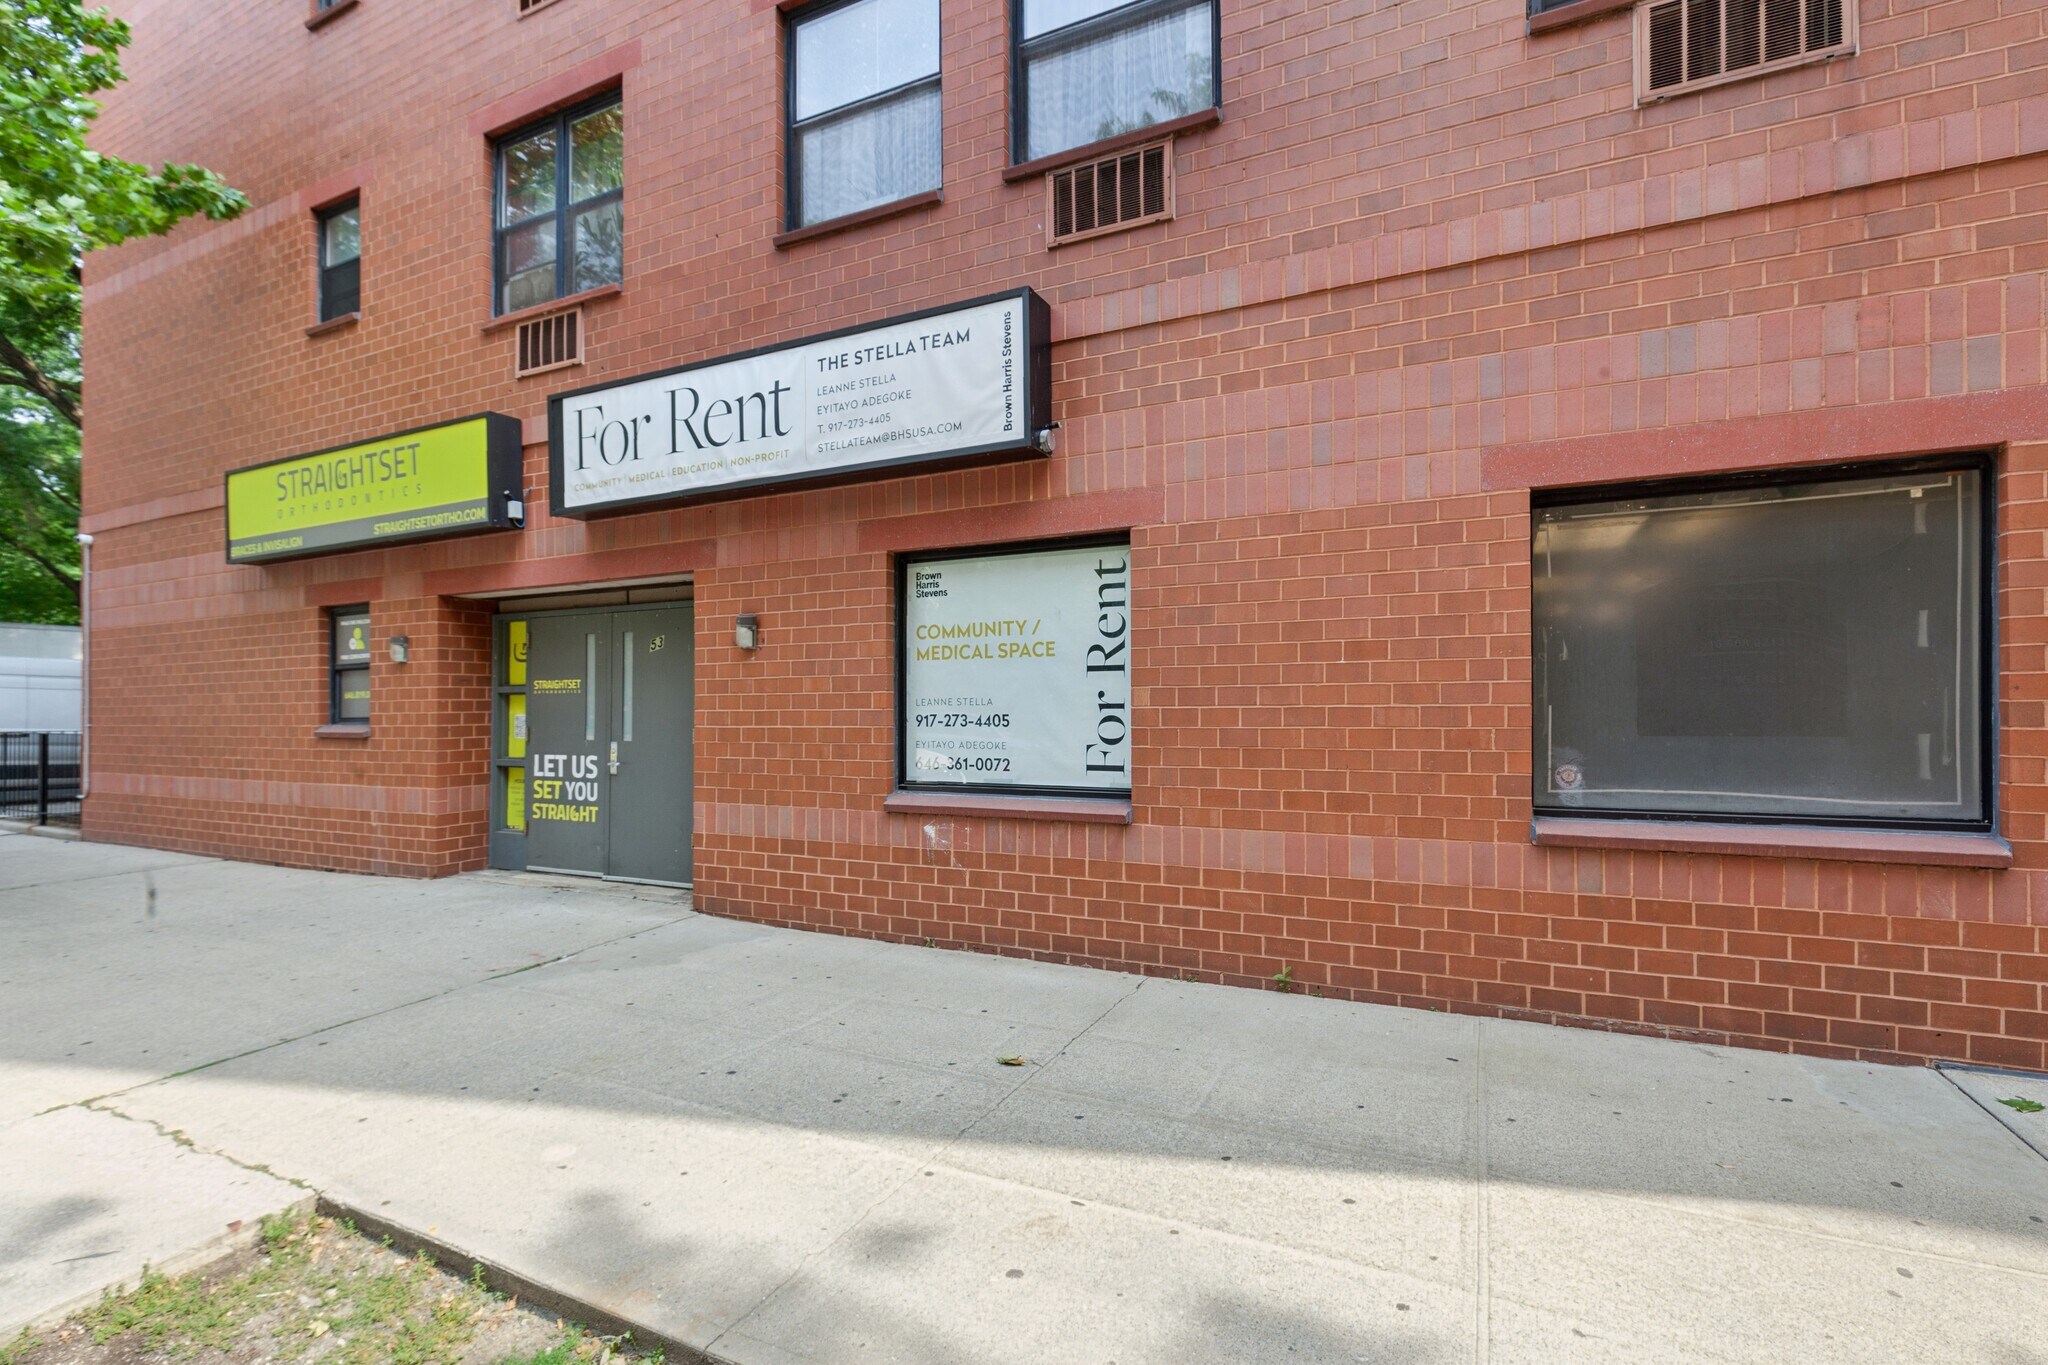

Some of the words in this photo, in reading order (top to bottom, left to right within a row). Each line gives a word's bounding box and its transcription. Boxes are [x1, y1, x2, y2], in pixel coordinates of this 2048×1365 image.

[1002, 311, 1012, 357] Stevens
[818, 353, 849, 372] THE
[854, 340, 916, 366] STELLA
[920, 328, 970, 351] TEAM
[817, 381, 856, 396] LEANNE
[859, 373, 896, 389] STELLA
[1003, 358, 1012, 393] Harris
[817, 399, 858, 415] EYITAYO
[862, 389, 912, 408] ADEGOKE
[1003, 395, 1013, 432] Brown
[573, 405, 652, 472] For
[664, 380, 793, 456] Rent
[817, 424, 826, 434] T.
[828, 413, 891, 433] 917-273-4405
[818, 421, 962, 453] STELLATEAM@BHSUSA.COM
[276, 443, 421, 502] STRAIGHTSET
[574, 478, 622, 492] COMMUNITY
[628, 472, 666, 484] MEDICAL
[672, 460, 723, 476] EDUCATION
[730, 450, 790, 467] NON-PROFIT
[277, 483, 422, 520] ORTHODONTICS
[373, 507, 486, 535] STRAIGHTSETORTHO.COM
[916, 571, 942, 581] Brown
[916, 580, 940, 590] Harris
[916, 588, 948, 598] Stevens
[1086, 556, 1127, 678] Rent
[916, 619, 1028, 640] COMMUNITY
[650, 636, 664, 650] 53
[916, 644, 994, 662] MEDICAL
[998, 640, 1056, 659] SPACE
[533, 679, 582, 690] STRAIGHTSET
[916, 698, 953, 707] LEANNE
[957, 697, 994, 706] STELLA
[916, 714, 1010, 728] 917-273-4405
[1086, 690, 1126, 776] For
[916, 740, 955, 750] EYITAYO
[958, 740, 1007, 750] ADEGOKE
[533, 754, 568, 778] LET
[571, 755, 598, 779] US
[533, 780, 562, 800] SET
[565, 781, 598, 802] YOU
[532, 802, 599, 823] STRAIGHT
